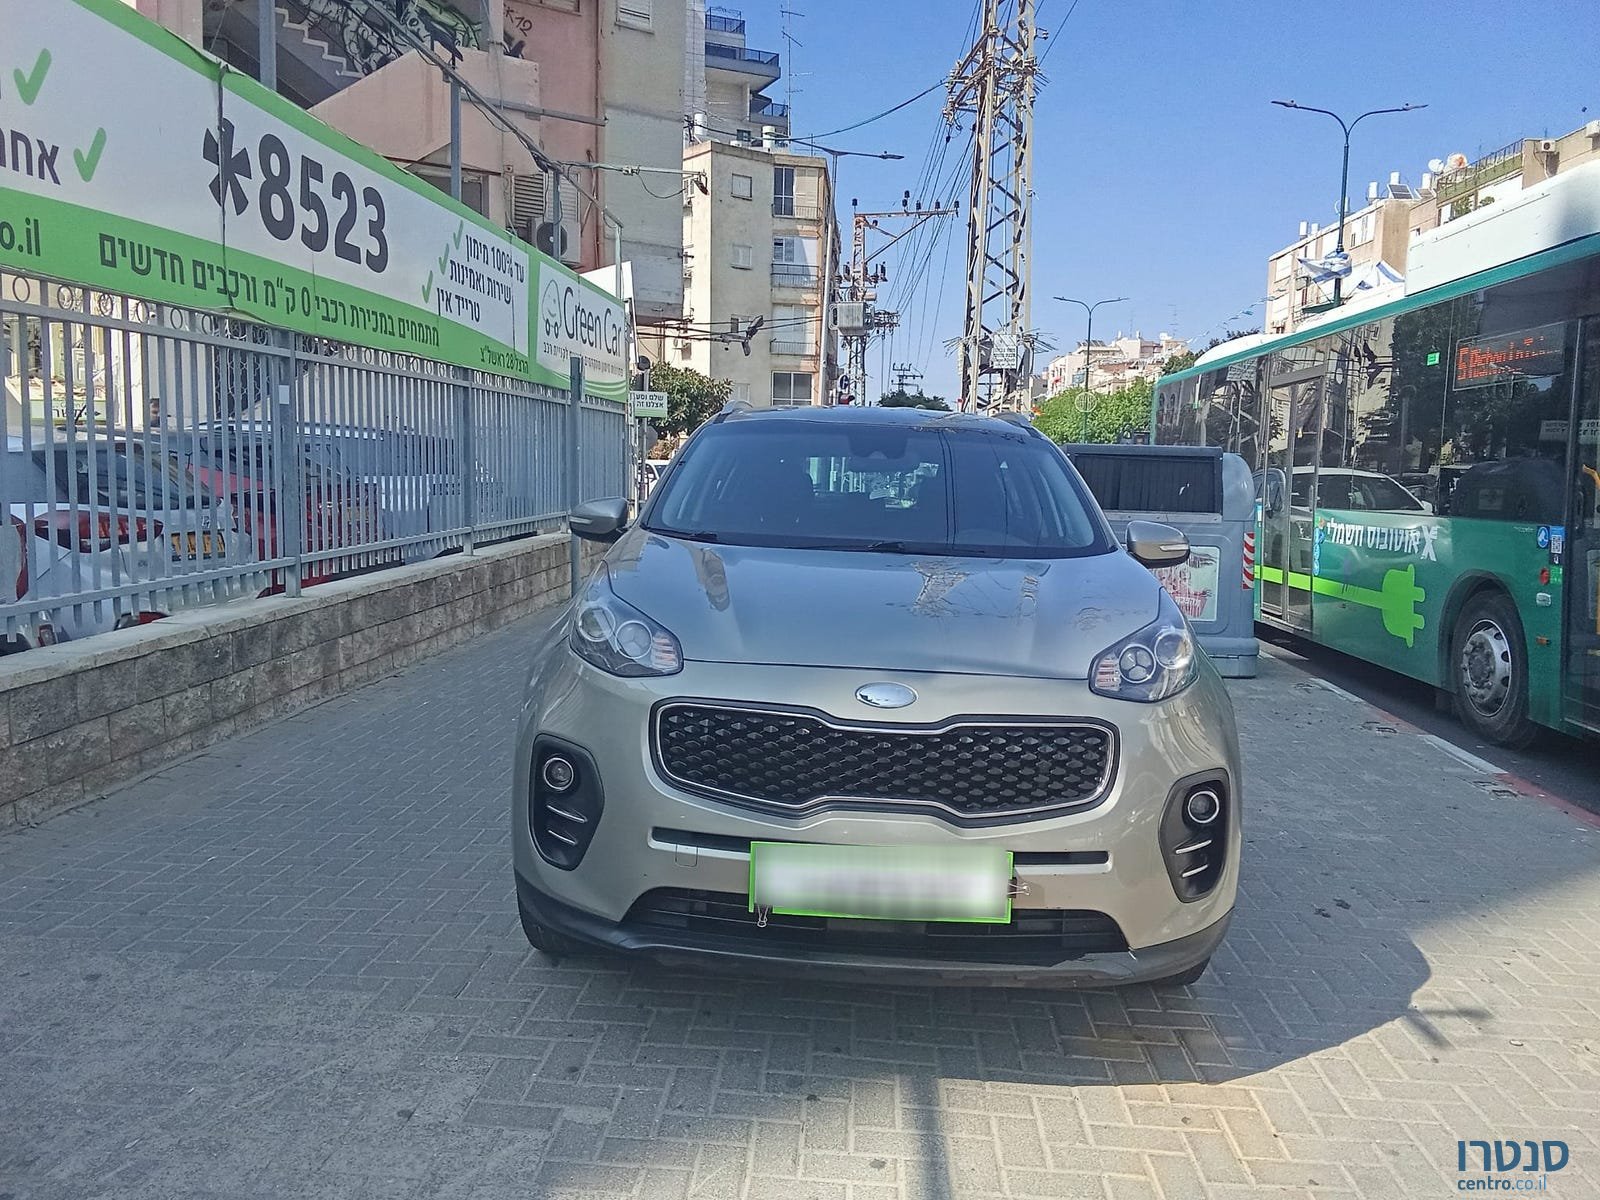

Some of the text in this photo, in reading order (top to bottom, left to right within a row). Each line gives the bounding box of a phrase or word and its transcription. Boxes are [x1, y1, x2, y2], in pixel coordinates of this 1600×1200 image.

[99, 233, 185, 285] חדשים
[466, 234, 525, 283] עד 100% מימון
[192, 259, 258, 303] ורכבים
[450, 260, 512, 305] שירות ואמינות
[301, 286, 311, 317] 0
[315, 295, 347, 326] רכבי
[437, 287, 481, 323] טרייד אין
[350, 304, 396, 337] במכירת
[398, 317, 440, 347] מתמחים
[563, 286, 622, 358] Green Car
[543, 341, 552, 355] רכב
[649, 393, 664, 401] שלם
[1326, 517, 1364, 547] חשמלי
